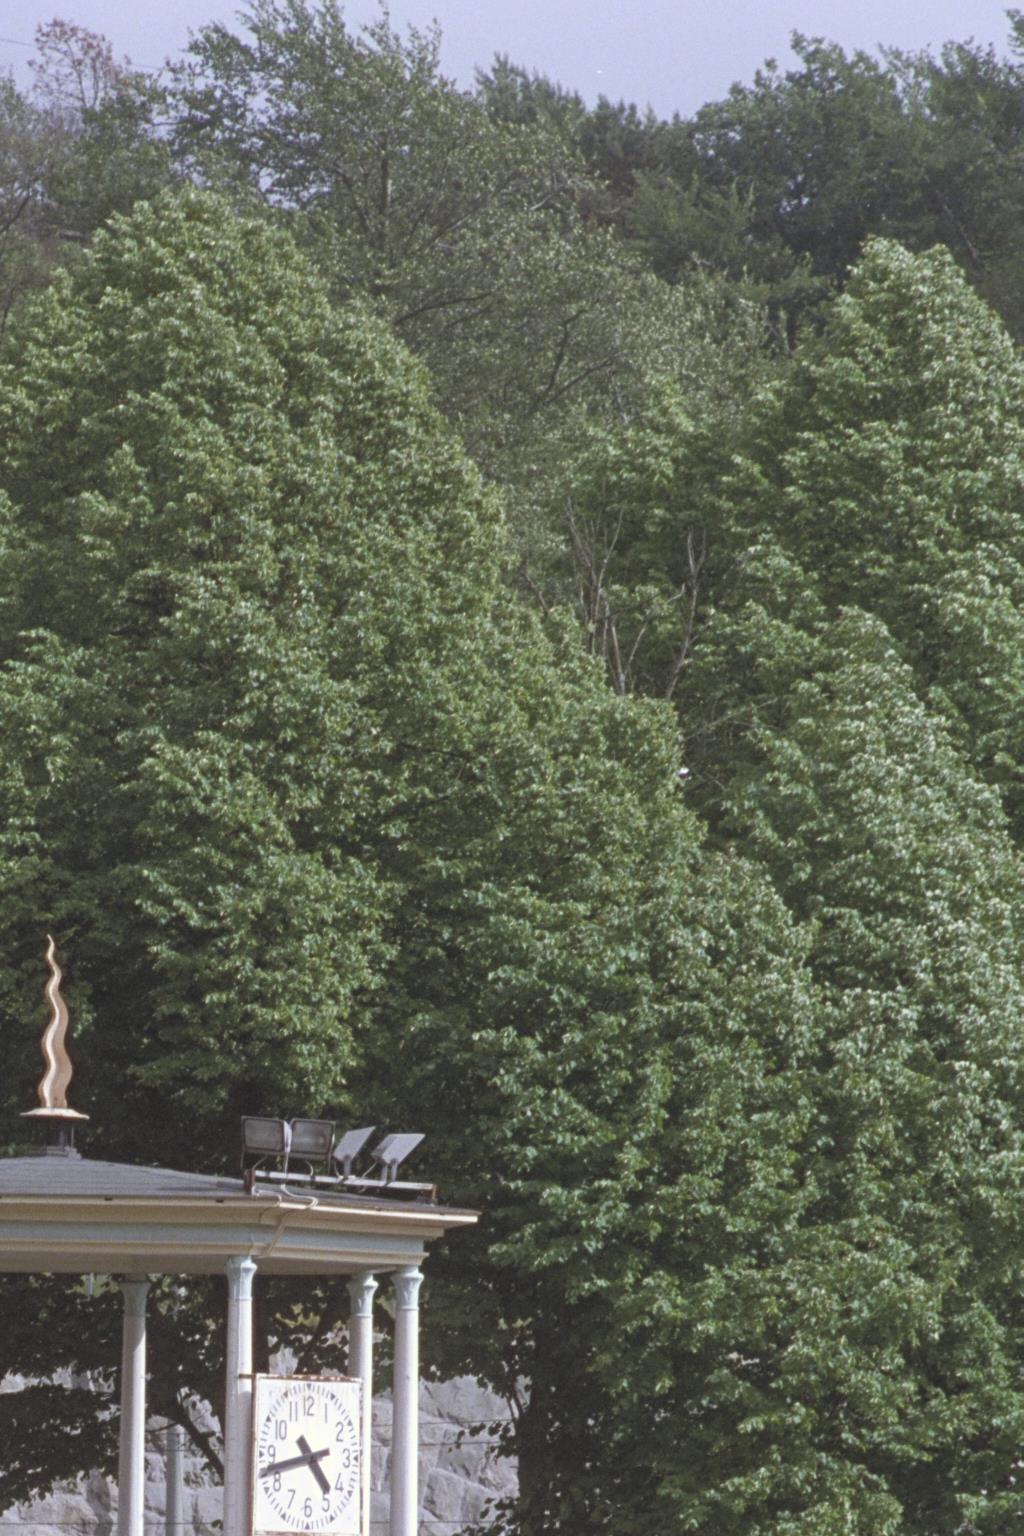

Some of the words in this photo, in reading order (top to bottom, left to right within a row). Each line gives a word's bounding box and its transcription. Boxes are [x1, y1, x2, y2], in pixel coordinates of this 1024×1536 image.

[289, 1402, 298, 1422] 11
[303, 1396, 315, 1416] 12
[275, 1419, 288, 1440] 10
[336, 1422, 344, 1442] 2
[267, 1445, 276, 1465] 9
[342, 1448, 351, 1468] 3
[273, 1471, 281, 1492] 8
[335, 1472, 344, 1492] 4
[287, 1489, 296, 1509] 7
[304, 1497, 312, 1517] 6
[322, 1495, 330, 1512] 5
